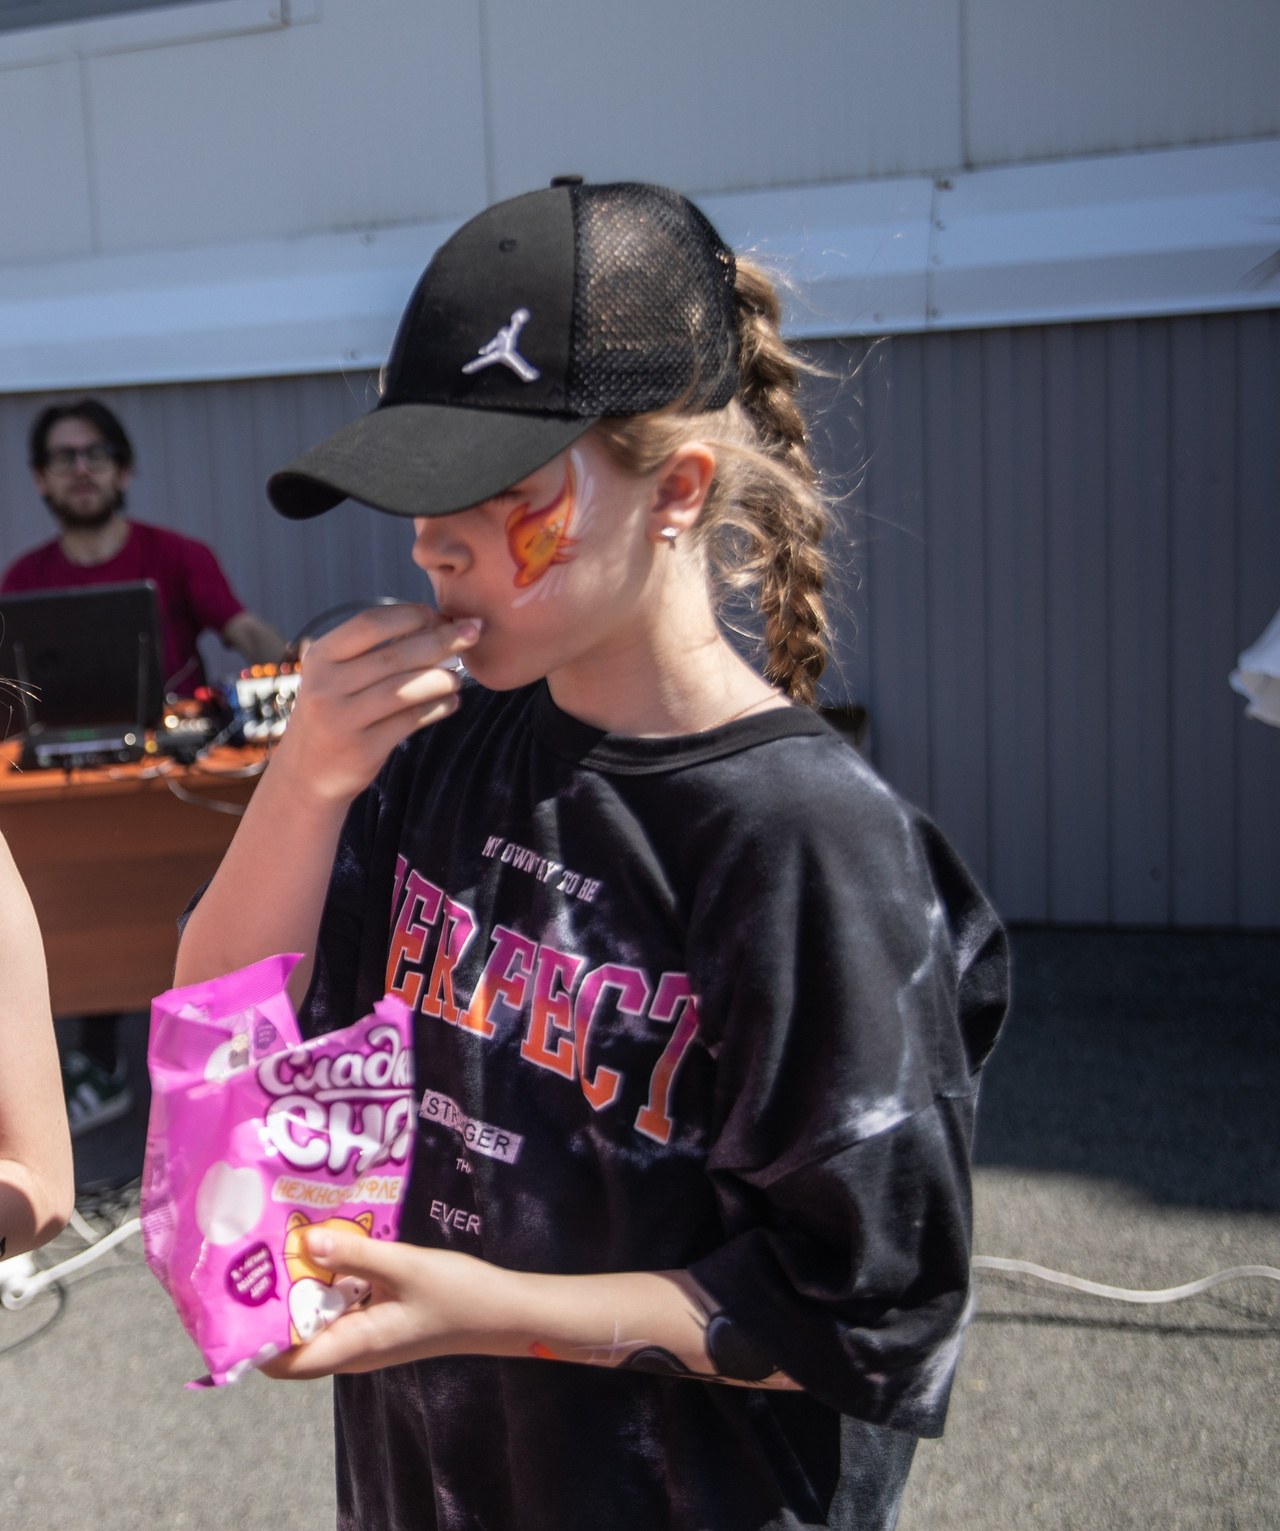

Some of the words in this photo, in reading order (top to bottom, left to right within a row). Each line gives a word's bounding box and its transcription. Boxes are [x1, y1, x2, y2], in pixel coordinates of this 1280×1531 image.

[481, 835, 504, 858] MY
[500, 843, 539, 873] OWN
[534, 856, 564, 883] AY
[556, 869, 582, 895] TO
[576, 878, 601, 903] BE
[430, 1200, 482, 1235] EVER
